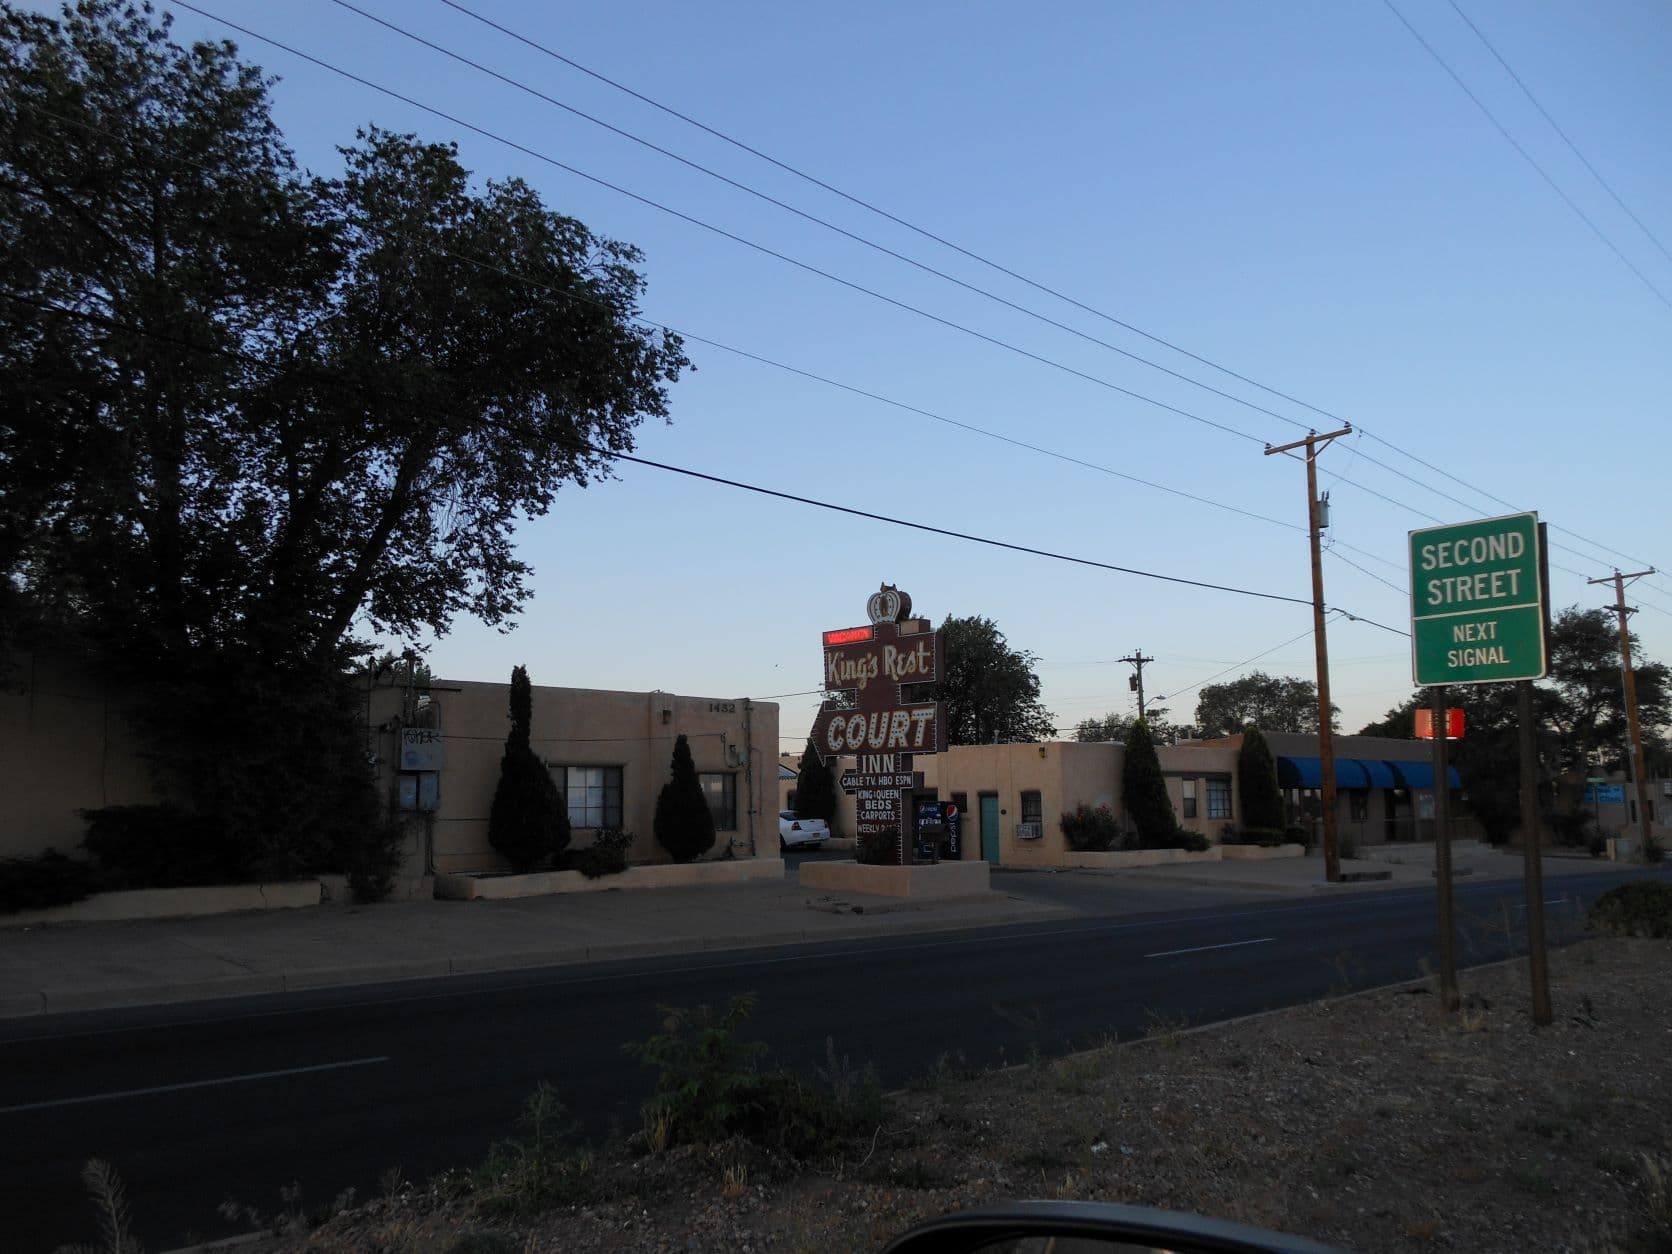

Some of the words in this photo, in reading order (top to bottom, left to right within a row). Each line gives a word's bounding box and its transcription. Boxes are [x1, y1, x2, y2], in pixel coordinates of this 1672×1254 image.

[1421, 531, 1525, 571] SECOND
[1427, 568, 1521, 606] STREET
[1452, 621, 1498, 643] NEXT
[826, 650, 879, 690] King's
[883, 640, 931, 682] Rest
[1447, 646, 1510, 668] SIGNAL
[827, 708, 935, 752] COURT
[861, 754, 896, 774] INN
[842, 776, 864, 787] CABLE
[878, 776, 893, 786] HBO
[895, 775, 912, 785] ESPN
[857, 789, 873, 800] KING
[876, 789, 900, 800] QUEEN
[865, 799, 893, 810] BEDS
[860, 810, 896, 821] CARPORTS
